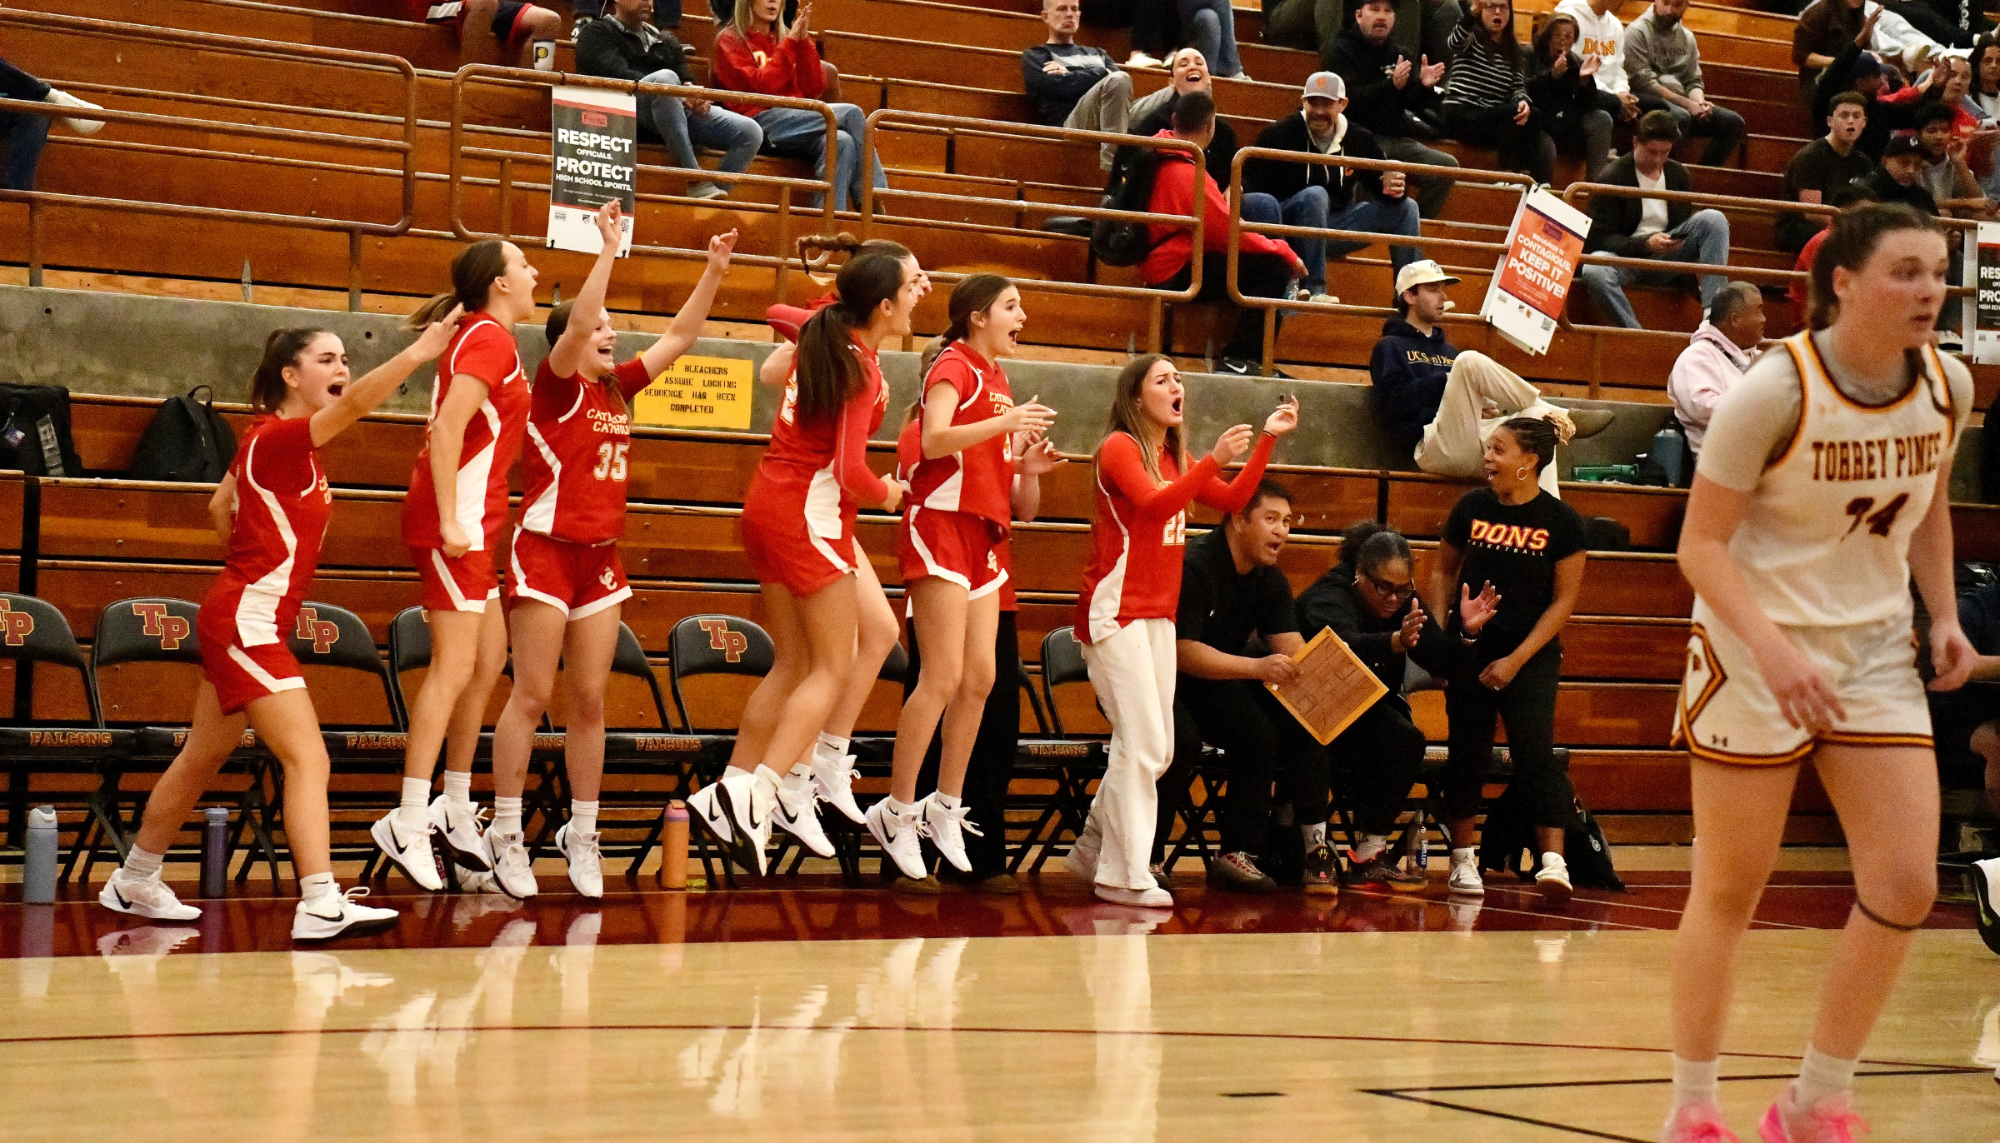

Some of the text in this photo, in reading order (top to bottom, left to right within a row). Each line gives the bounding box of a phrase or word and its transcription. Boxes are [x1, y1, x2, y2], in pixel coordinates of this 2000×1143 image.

[557, 128, 633, 153] RESPECT
[576, 148, 613, 160] OFFICIALS.
[556, 156, 633, 181] PROTECT
[555, 173, 633, 192] HIGH SCHOOL SPORTS.
[1519, 247, 1564, 281] KEEP IT
[1508, 257, 1566, 299] POSITIVE!
[684, 364, 728, 375] BLEACHERS
[664, 376, 737, 389] ASSURE LOCKING
[644, 388, 736, 402] SEQUENCE HAS BEEN
[670, 403, 714, 414] COMPLETED
[593, 441, 630, 482] 35
[1811, 437, 1888, 482] TORREY
[1162, 508, 1186, 547] 22
[1470, 518, 1550, 551] DONS
[132, 603, 191, 651] TP
[698, 619, 748, 663] TP
[30, 731, 112, 747] FALCONS
[346, 734, 407, 750] FALCON
[635, 737, 702, 751] FALCONS
[1028, 745, 1089, 757] FALCONS
